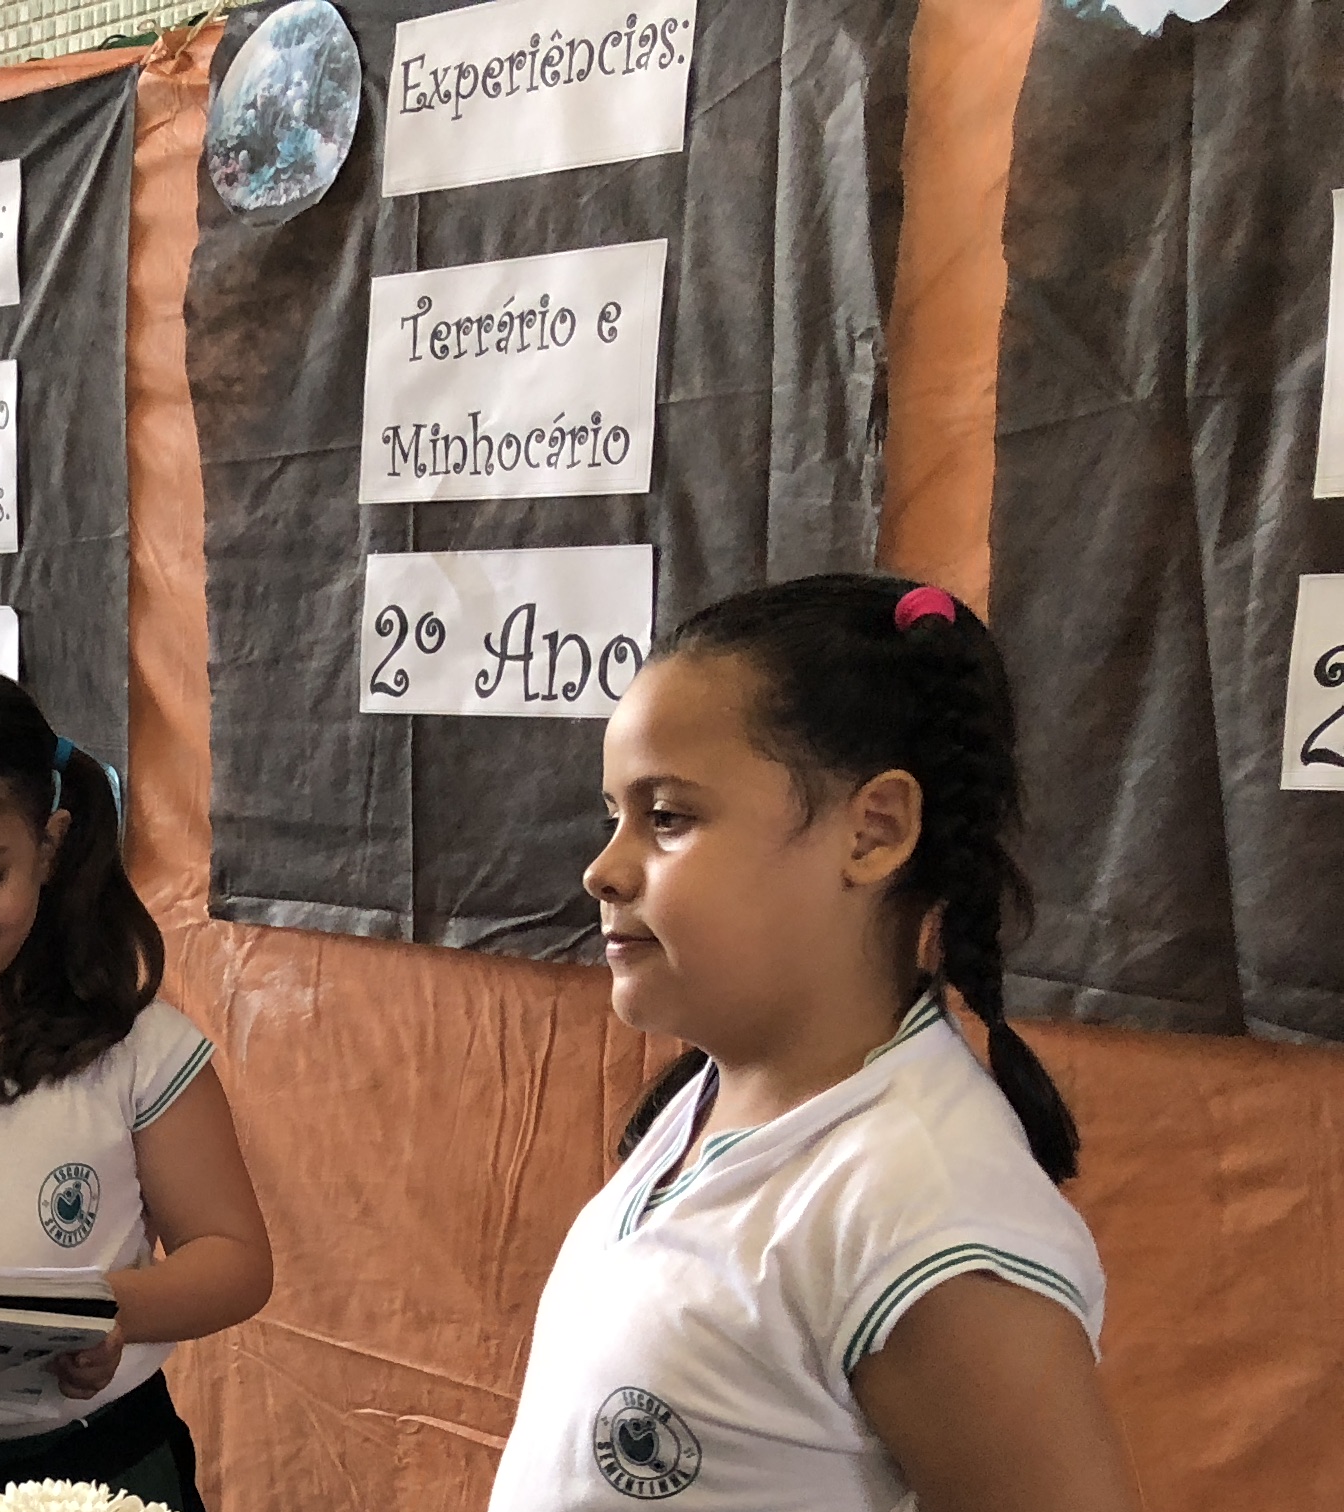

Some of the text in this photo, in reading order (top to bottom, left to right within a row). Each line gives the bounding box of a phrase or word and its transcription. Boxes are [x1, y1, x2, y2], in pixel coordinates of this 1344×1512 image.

[398, 13, 690, 120] Experiências:
[401, 293, 622, 362] Terrário e
[381, 410, 630, 479] Minhocário
[475, 602, 644, 701] Ano
[53, 1165, 91, 1184] ESCOLA
